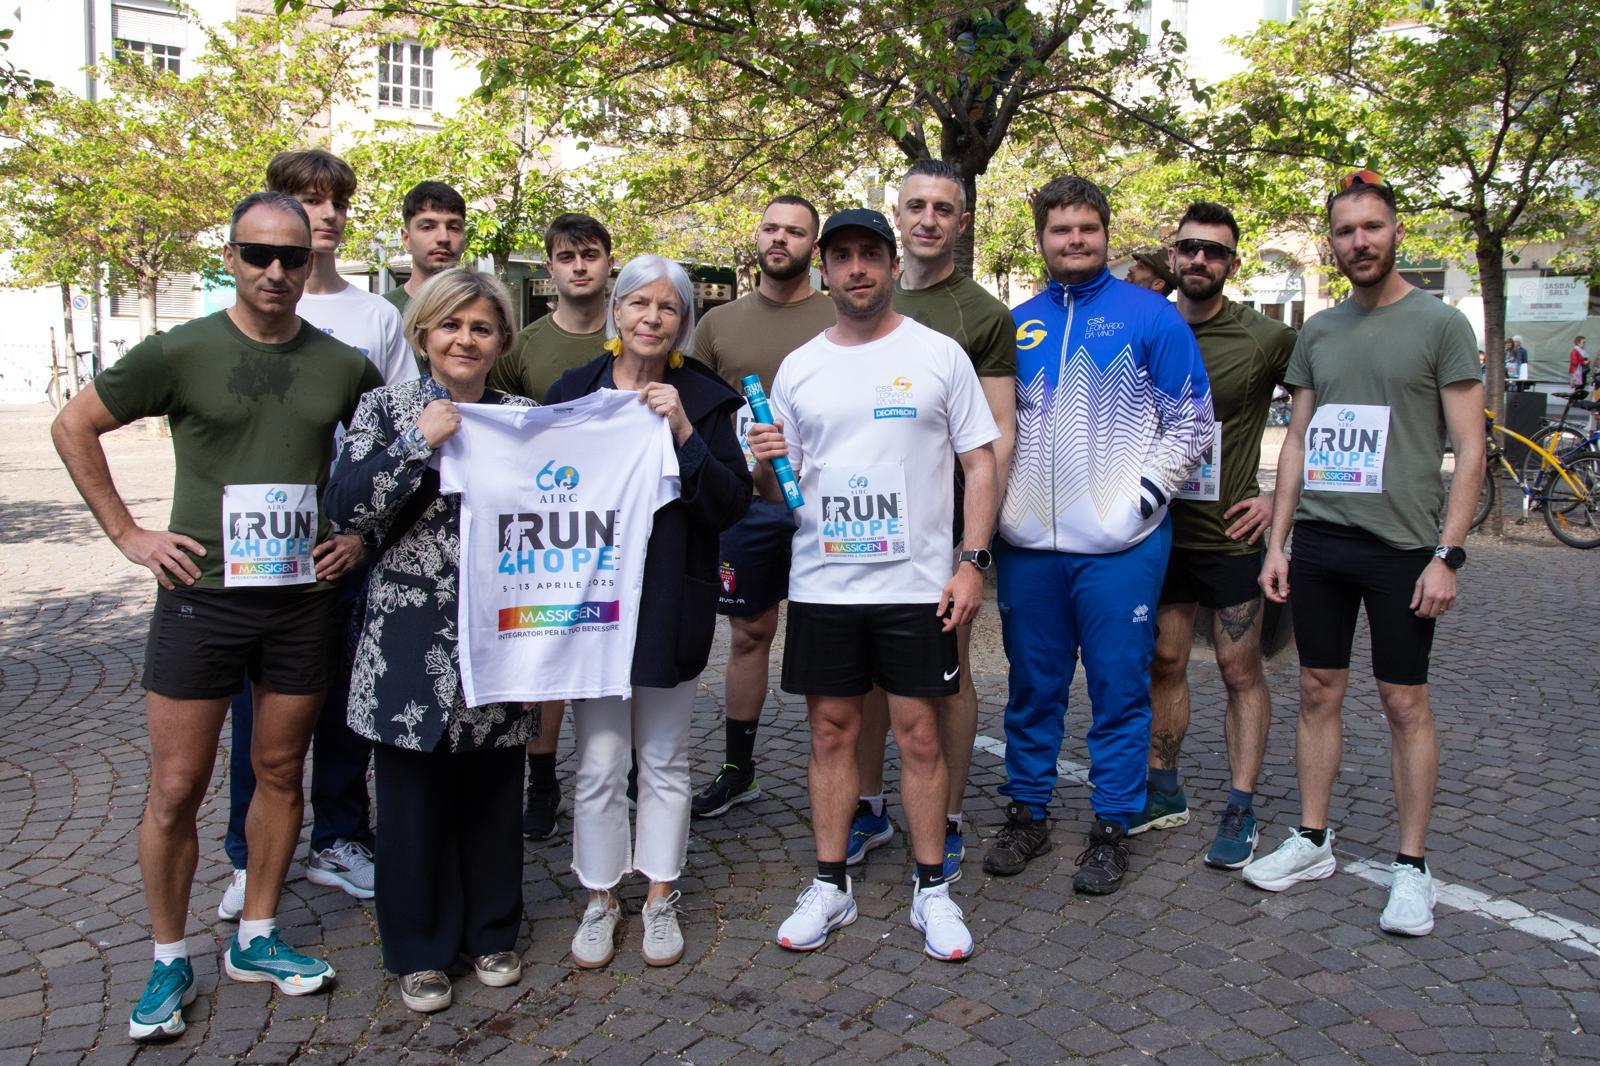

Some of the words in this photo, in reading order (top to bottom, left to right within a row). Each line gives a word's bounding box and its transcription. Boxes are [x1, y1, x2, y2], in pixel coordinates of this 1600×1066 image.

[1087, 317, 1104, 325] CSS
[875, 408, 916, 417] DECATHLON
[1309, 427, 1379, 453] RUN
[1308, 451, 1374, 467] 4HOPE
[1312, 471, 1357, 480] MASSIGEN
[540, 493, 579, 504] AIRC
[821, 492, 899, 522] RUN
[229, 511, 312, 541] RUN
[498, 509, 616, 553] RUN
[823, 518, 899, 537] 4HOPE
[231, 538, 309, 557] 4HOPE
[830, 542, 882, 553] MASSIGEN
[497, 545, 615, 576] 4HOPE
[239, 563, 294, 575] MASSIGEN
[536, 581, 582, 591] APRILE
[519, 606, 601, 624] MASSIGEN
[498, 630, 544, 640] INTEGRATORI
[568, 626, 582, 635] TUO
